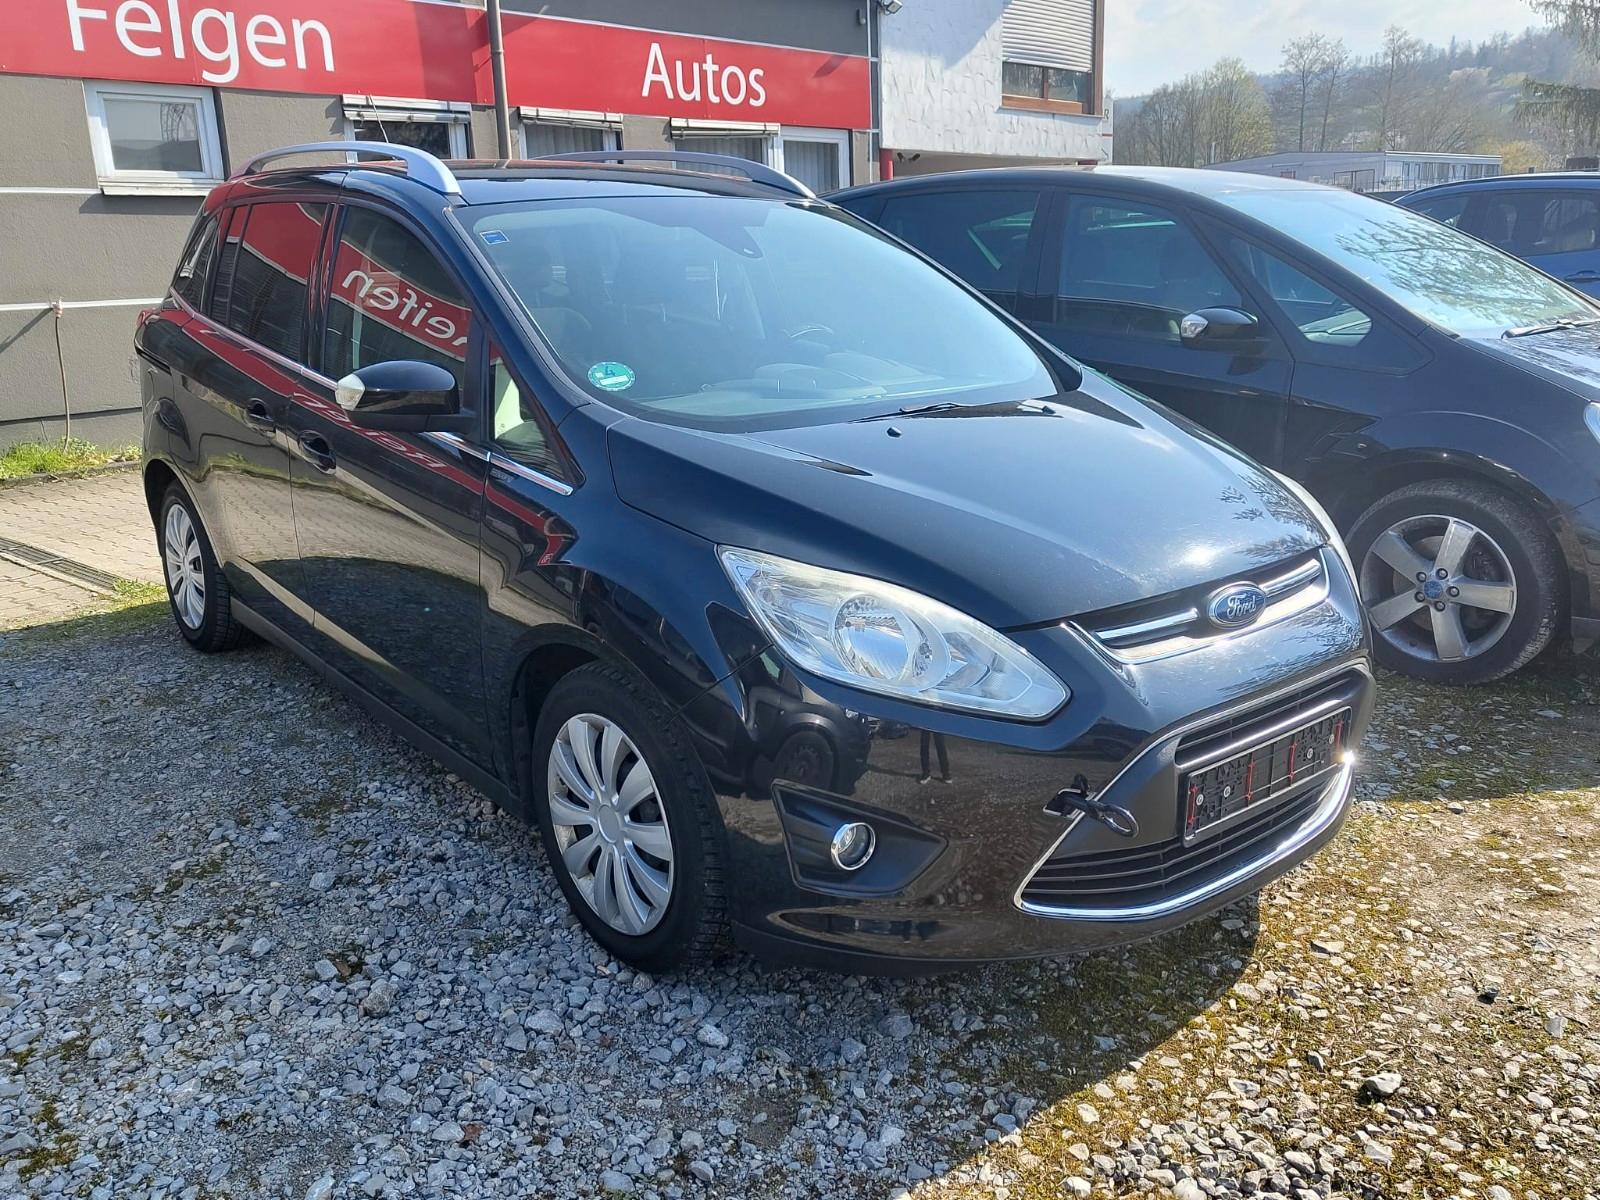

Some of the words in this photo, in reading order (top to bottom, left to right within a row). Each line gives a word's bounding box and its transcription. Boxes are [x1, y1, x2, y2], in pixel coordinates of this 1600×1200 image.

[66, 0, 335, 83] Felgen
[641, 42, 767, 107] Autos
[1226, 593, 1257, 619] Ford
